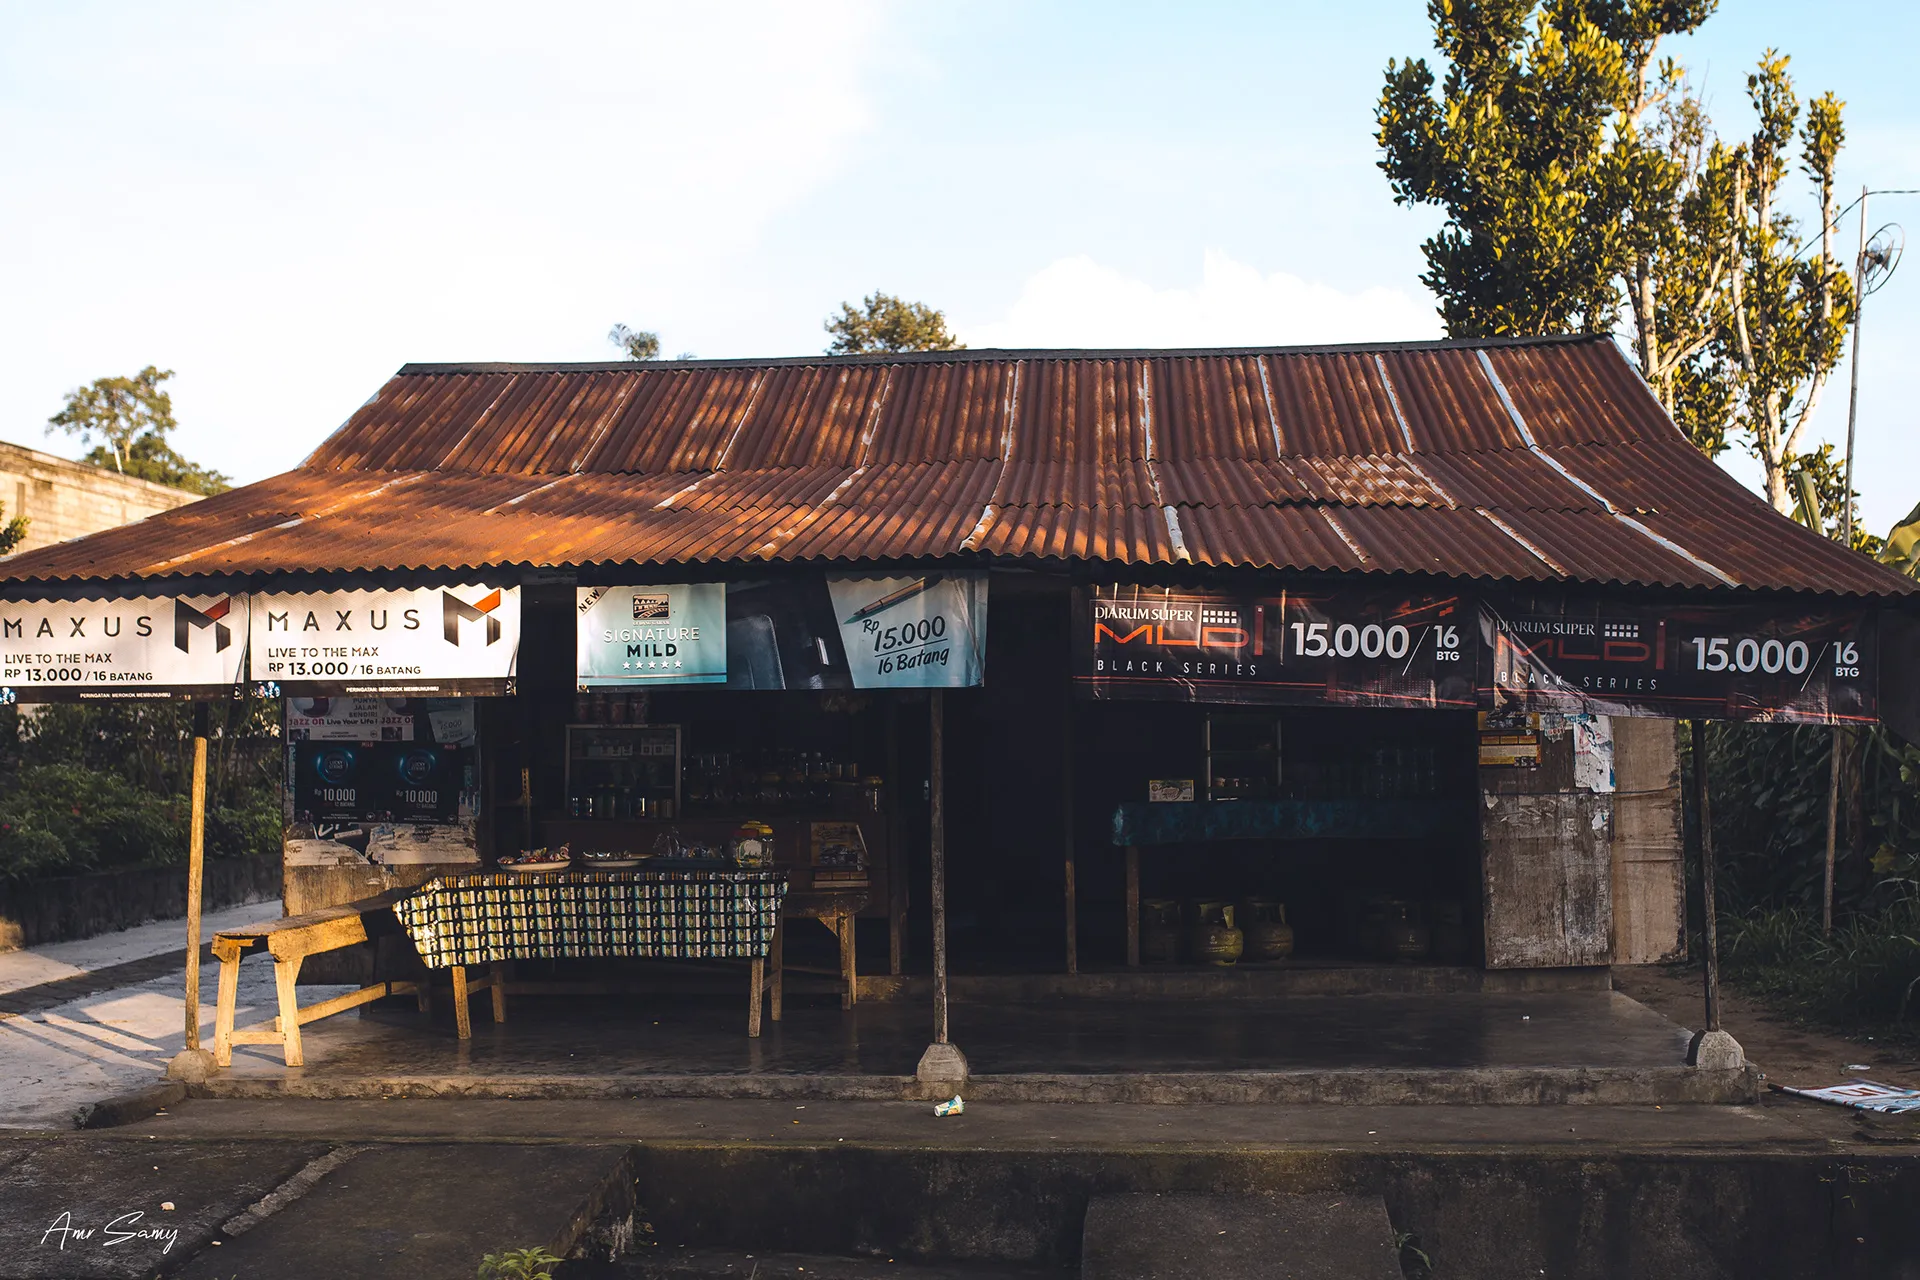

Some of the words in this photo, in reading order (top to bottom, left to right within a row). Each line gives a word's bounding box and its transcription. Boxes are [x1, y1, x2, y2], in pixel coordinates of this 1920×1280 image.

[578, 589, 601, 613] NEW
[268, 609, 421, 632] MAXUS
[1095, 606, 1150, 620] DJARUM
[1151, 608, 1195, 622] SUPER
[3, 615, 153, 638] MAXUS
[862, 619, 880, 635] Rp
[874, 615, 946, 652] 15.000
[1496, 620, 1550, 634] DJARUM
[1553, 622, 1596, 636] SUPER
[603, 627, 701, 643] SIGNATURE
[1290, 622, 1410, 659] 15.000
[1433, 624, 1460, 649] 16
[5, 654, 33, 664] LIVE
[35, 654, 52, 664] TO
[55, 654, 81, 664] THE
[84, 653, 112, 664] MAX
[268, 648, 297, 658] LIVE
[301, 648, 318, 658] TO
[322, 647, 348, 657] THE
[351, 647, 379, 657] MAX
[627, 643, 678, 658] MILD
[1435, 651, 1460, 661] BTG
[1691, 637, 1810, 675] 15.000
[1832, 641, 1859, 665] 16
[268, 662, 284, 672] RP
[288, 661, 348, 676] 13.000
[360, 664, 374, 675] 16
[377, 665, 421, 675] BATANG
[877, 658, 894, 676] 16
[896, 648, 950, 672] Batang
[1097, 660, 1163, 673] BLACK
[1183, 662, 1256, 676] SERIES
[4, 669, 21, 679] RP
[25, 668, 82, 682] 13.000
[93, 671, 107, 681] 16
[109, 672, 153, 681] BATANG
[1835, 666, 1860, 677] BTG
[1501, 671, 1564, 686] BLACK
[1584, 676, 1657, 690] SERIES
[312, 717, 325, 726] on
